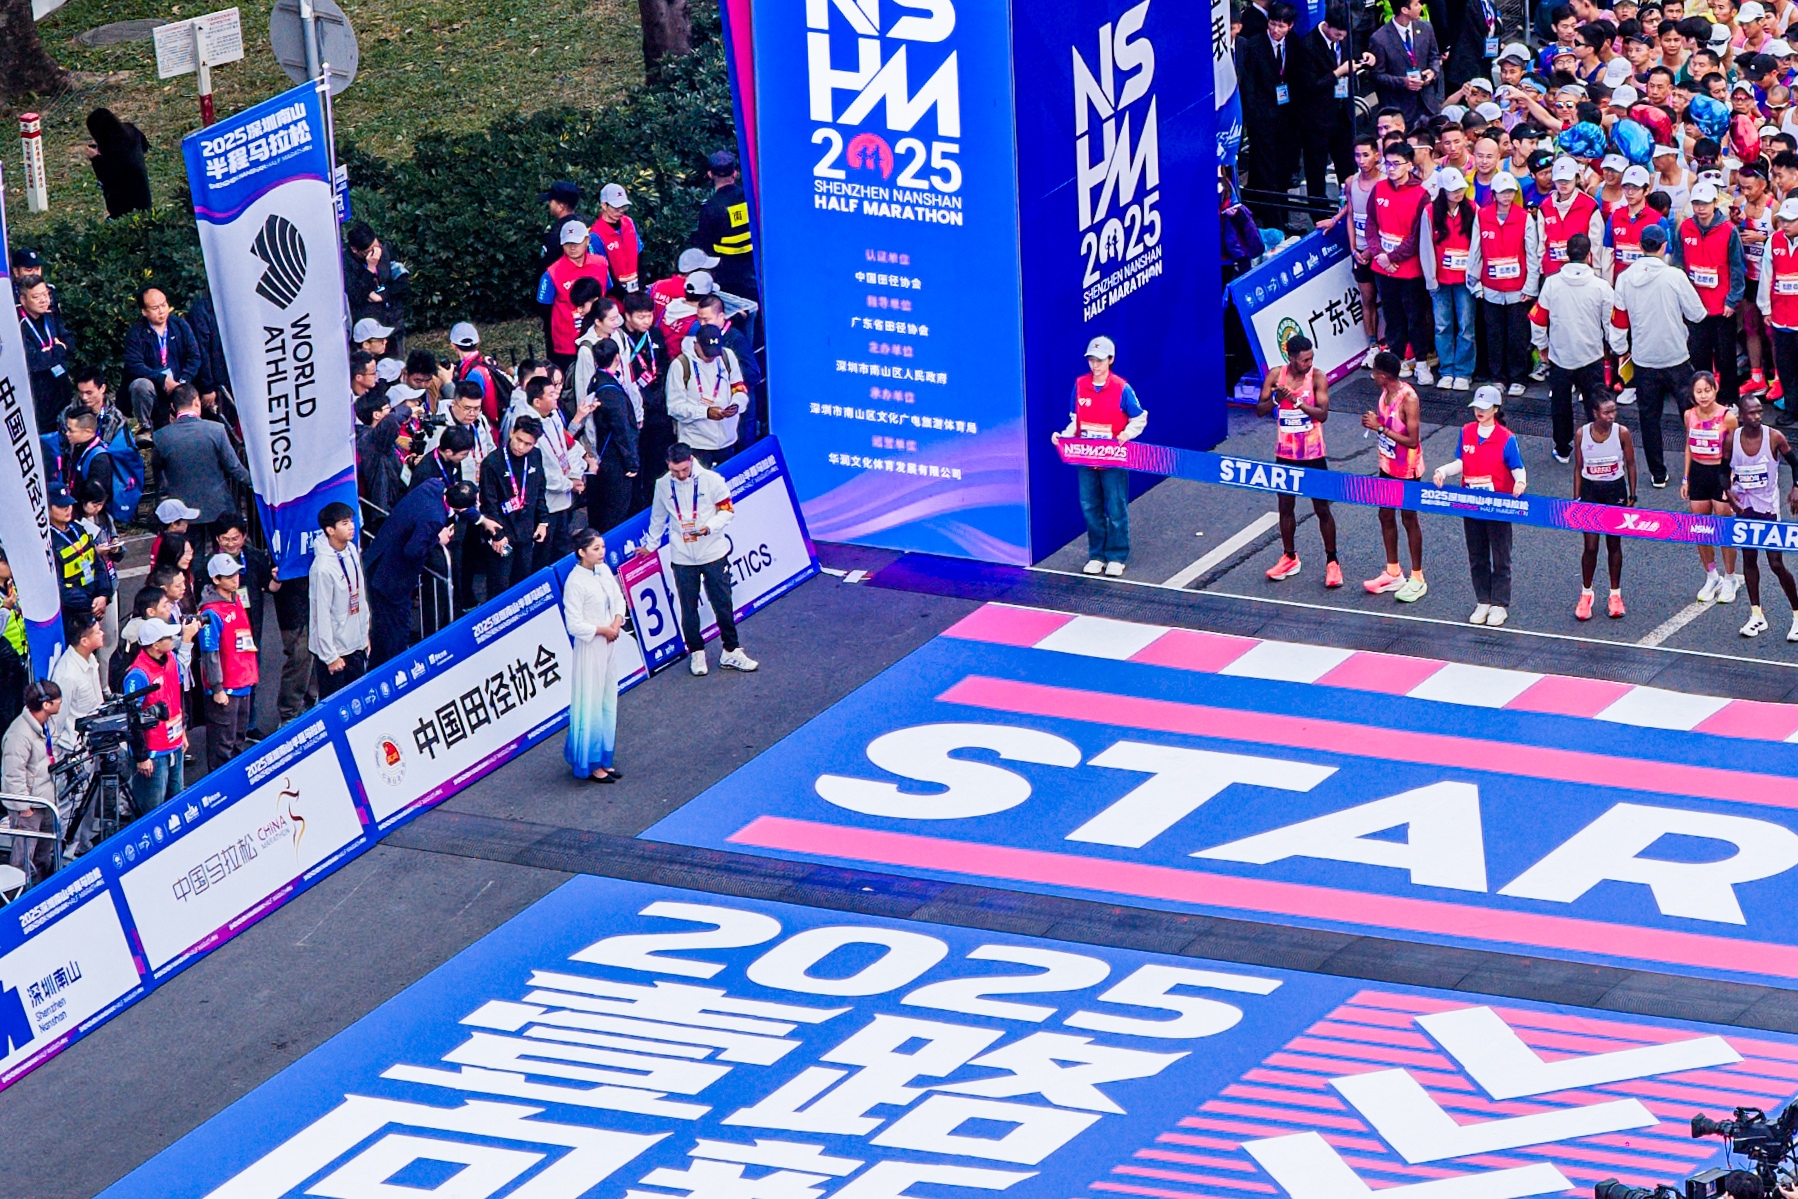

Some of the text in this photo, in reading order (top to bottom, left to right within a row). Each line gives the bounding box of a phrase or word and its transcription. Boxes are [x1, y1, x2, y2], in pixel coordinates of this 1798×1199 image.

[807, 31, 960, 138] HM
[200, 103, 306, 157] 2025深圳南山
[206, 120, 312, 180] 半程马拉松
[811, 128, 962, 193] 2025
[1076, 94, 1159, 232] HM
[814, 179, 962, 209] SHENZHEN NANSHAN
[815, 194, 963, 226] HALF MARATHON
[1080, 190, 1161, 289] 2025
[855, 271, 922, 290] 中国田径协会
[1083, 244, 1162, 304] SHENZHEN NANSHAN
[1083, 259, 1163, 322] HALF MARATHON
[851, 316, 929, 337] 广东省田径协会
[290, 312, 317, 418] WORLD
[836, 359, 947, 385] 深圳市南山区人民政府
[263, 325, 293, 475] ATHLETICS
[828, 452, 963, 480] 华润文化体育发展有限公司
[1219, 460, 1305, 493] START
[640, 588, 665, 637] 3
[412, 644, 562, 760] 中国田径协会
[257, 815, 288, 841] CHINA
[172, 834, 258, 902] 中国马拉松
[26, 960, 82, 1008] 深圳南山
[568, 901, 1283, 1039] 2025
[34, 997, 67, 1022] Shenzhen
[39, 1011, 68, 1033] Nanshan
[381, 970, 1192, 1166] 壹路
